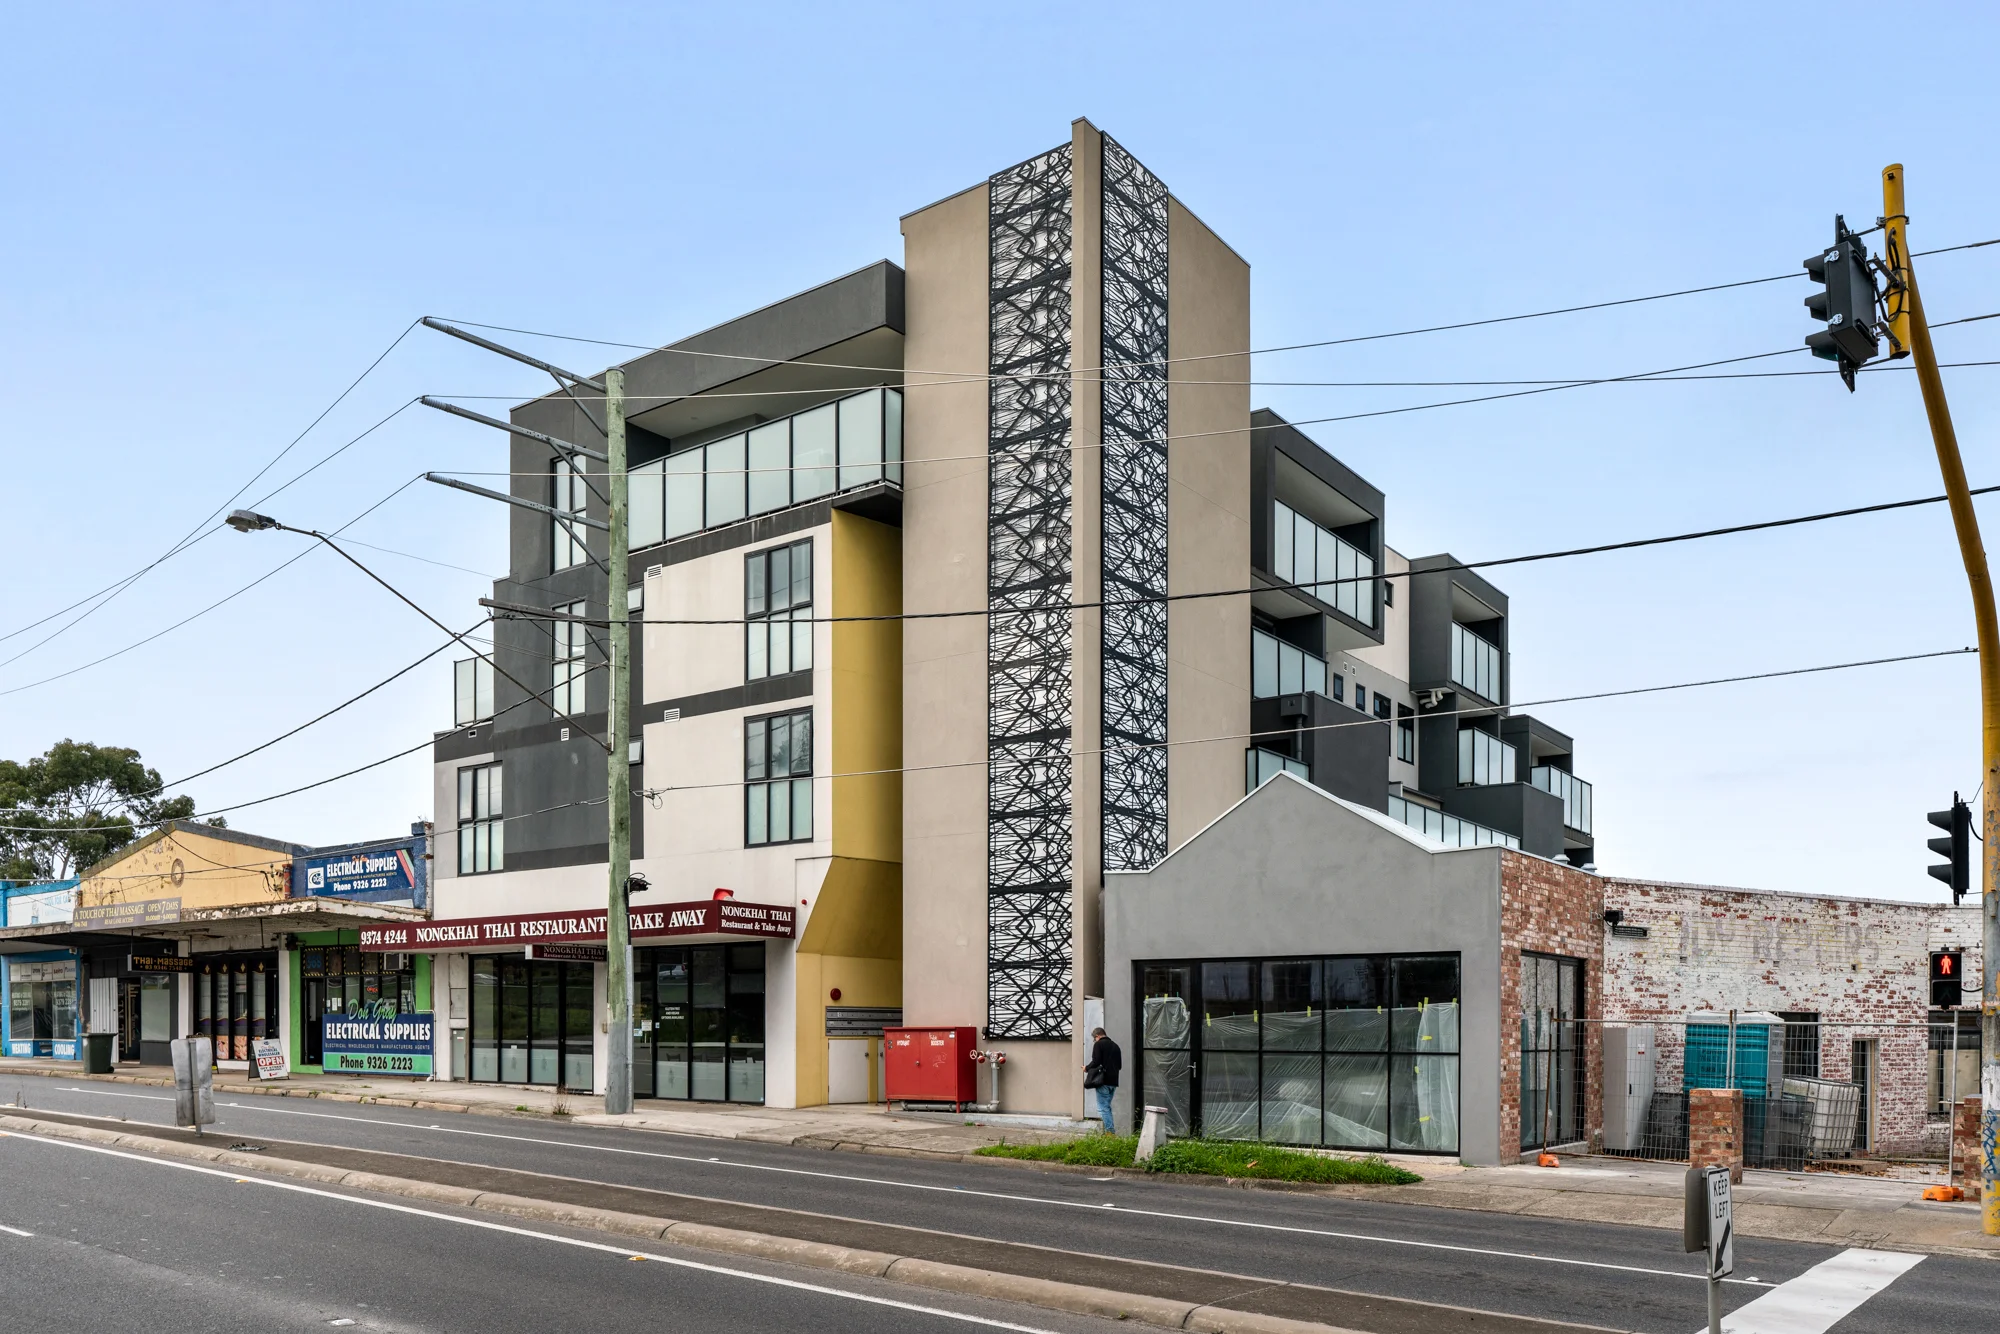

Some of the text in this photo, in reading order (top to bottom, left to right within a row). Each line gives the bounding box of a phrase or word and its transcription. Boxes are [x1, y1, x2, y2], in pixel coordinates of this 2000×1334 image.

[327, 856, 398, 877] ELECTRICAL SUPPLIES
[334, 878, 387, 891] Phone 9326 2223
[74, 911, 79, 920] A
[80, 907, 97, 919] TOUCH
[97, 906, 105, 917] OF
[106, 904, 120, 916] THAI
[120, 904, 145, 915] MASSAGE
[147, 901, 161, 912] OPEN
[161, 900, 166, 914] 7
[166, 900, 179, 911] DAYS
[721, 905, 791, 922] NONGKHAI THAI
[361, 908, 707, 945] 9374 4244 NONGKHAI THAI RESTAURANT TAKE AWAY
[721, 919, 791, 936] Restaurant & Take Away
[543, 945, 605, 956] NONGKHAI THAI
[348, 998, 397, 1027] Don Gray
[326, 1022, 431, 1042] ELECTRICAL SUPPLIES
[11, 1042, 32, 1055] HEATING
[54, 1043, 76, 1057] COOLING
[259, 1057, 283, 1066] OPEN
[340, 1055, 413, 1071] Phone 9326 2223
[1713, 1178, 1728, 1197] KEEP
[1714, 1200, 1729, 1219] LEFT
